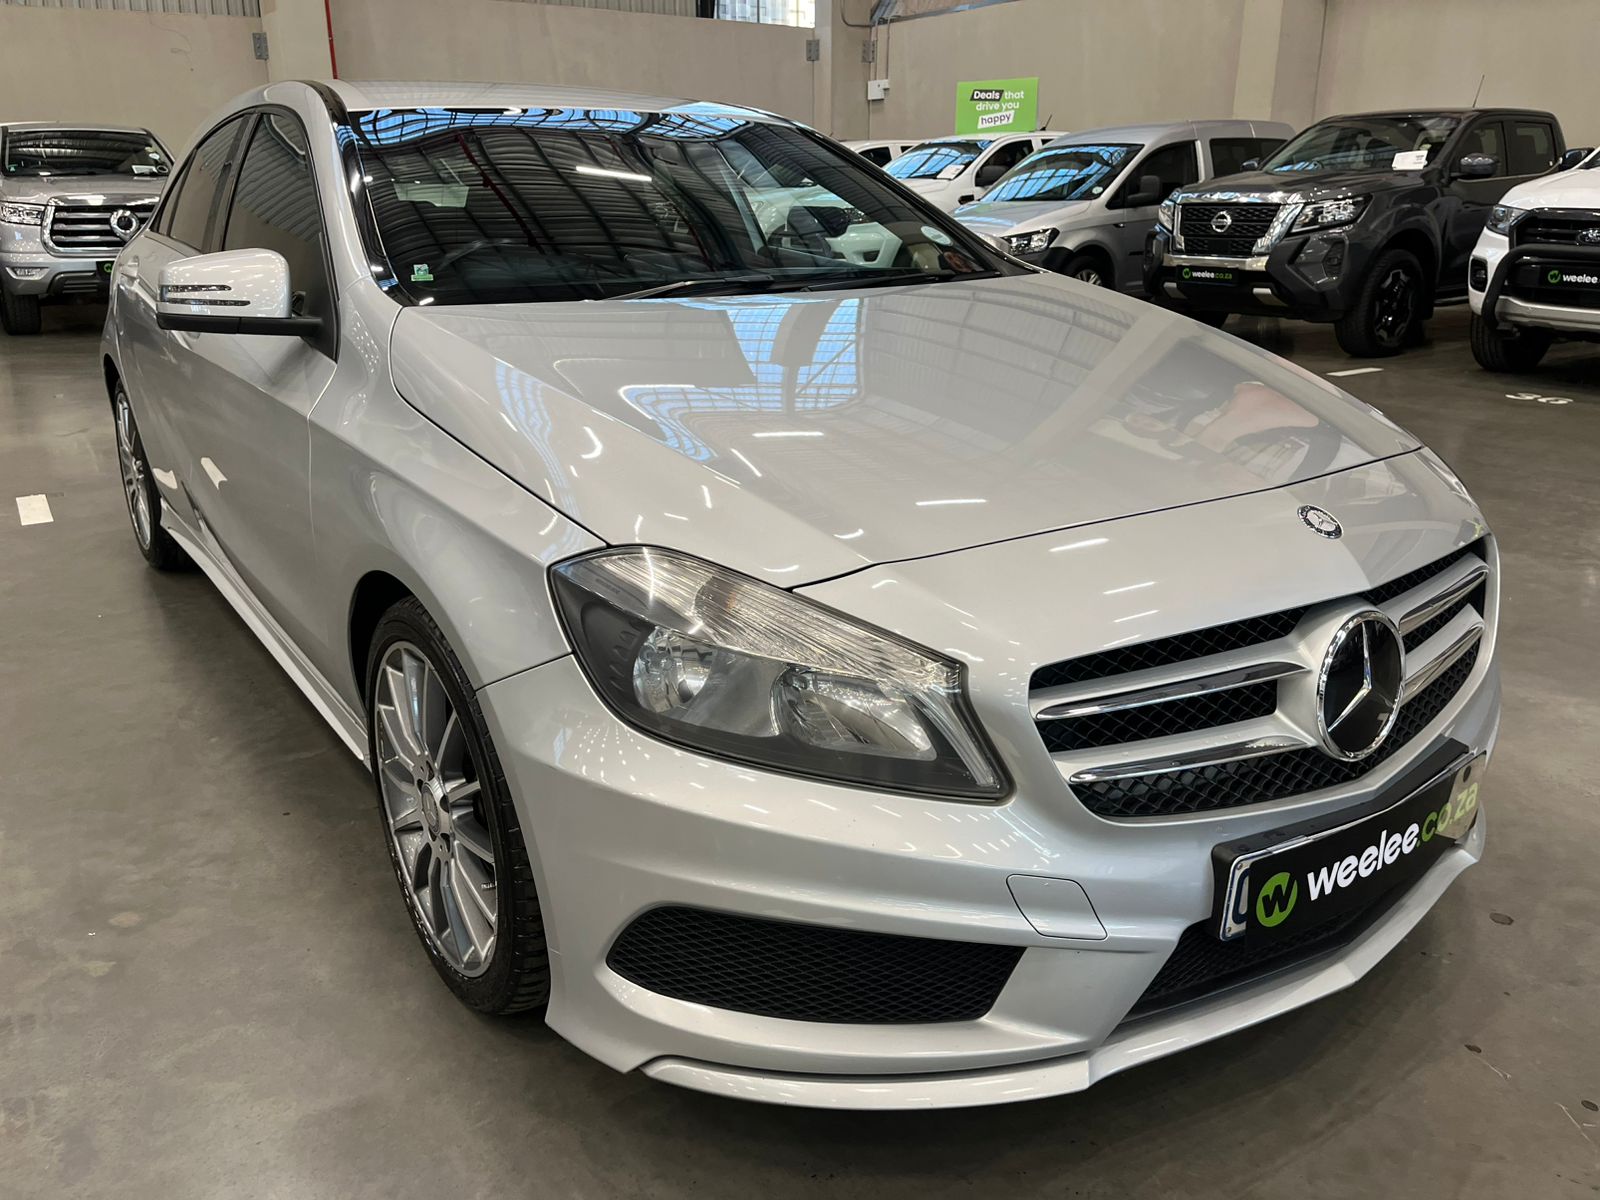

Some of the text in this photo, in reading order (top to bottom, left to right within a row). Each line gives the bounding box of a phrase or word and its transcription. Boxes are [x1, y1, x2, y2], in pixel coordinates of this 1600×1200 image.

[973, 90, 1025, 100] Deals that
[975, 101, 1020, 112] drive you
[980, 112, 1012, 125] happy
[1306, 782, 1479, 901] weelee.co.za
